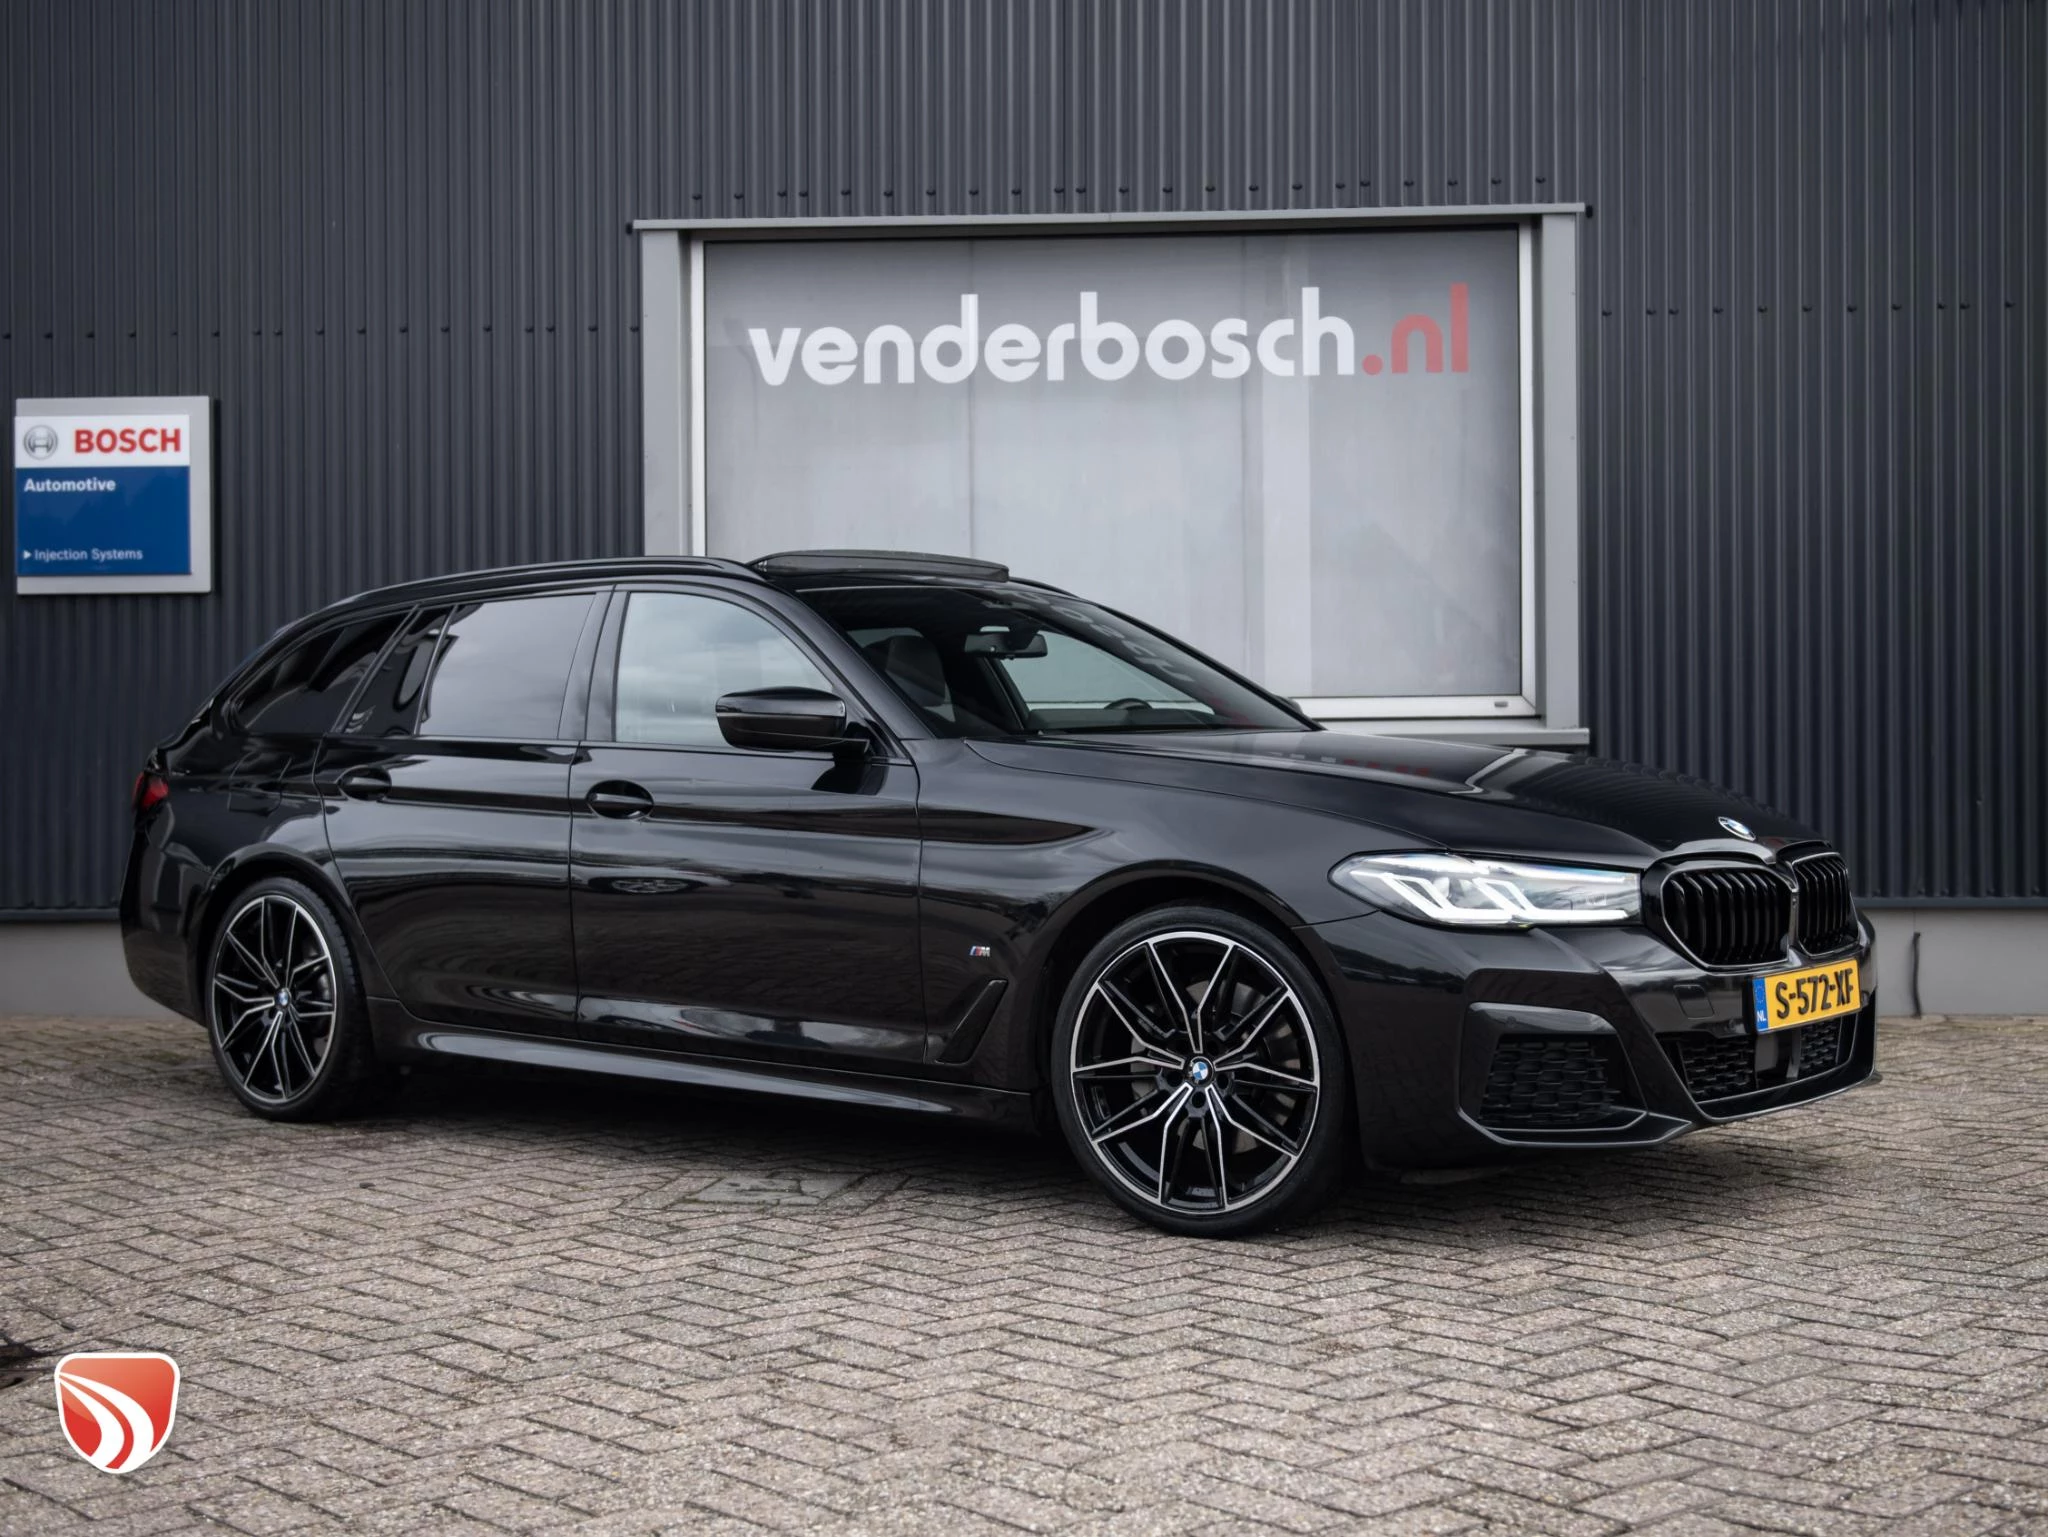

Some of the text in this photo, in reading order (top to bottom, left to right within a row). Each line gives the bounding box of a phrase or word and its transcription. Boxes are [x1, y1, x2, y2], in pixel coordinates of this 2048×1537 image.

[748, 283, 1469, 386] venderbosch.nl
[74, 428, 181, 453] BOSCH
[24, 477, 116, 492] Automotive
[34, 548, 143, 562] Injection Systems
[1775, 968, 1853, 1019] S-572-XF
[1756, 1010, 1767, 1022] NL
